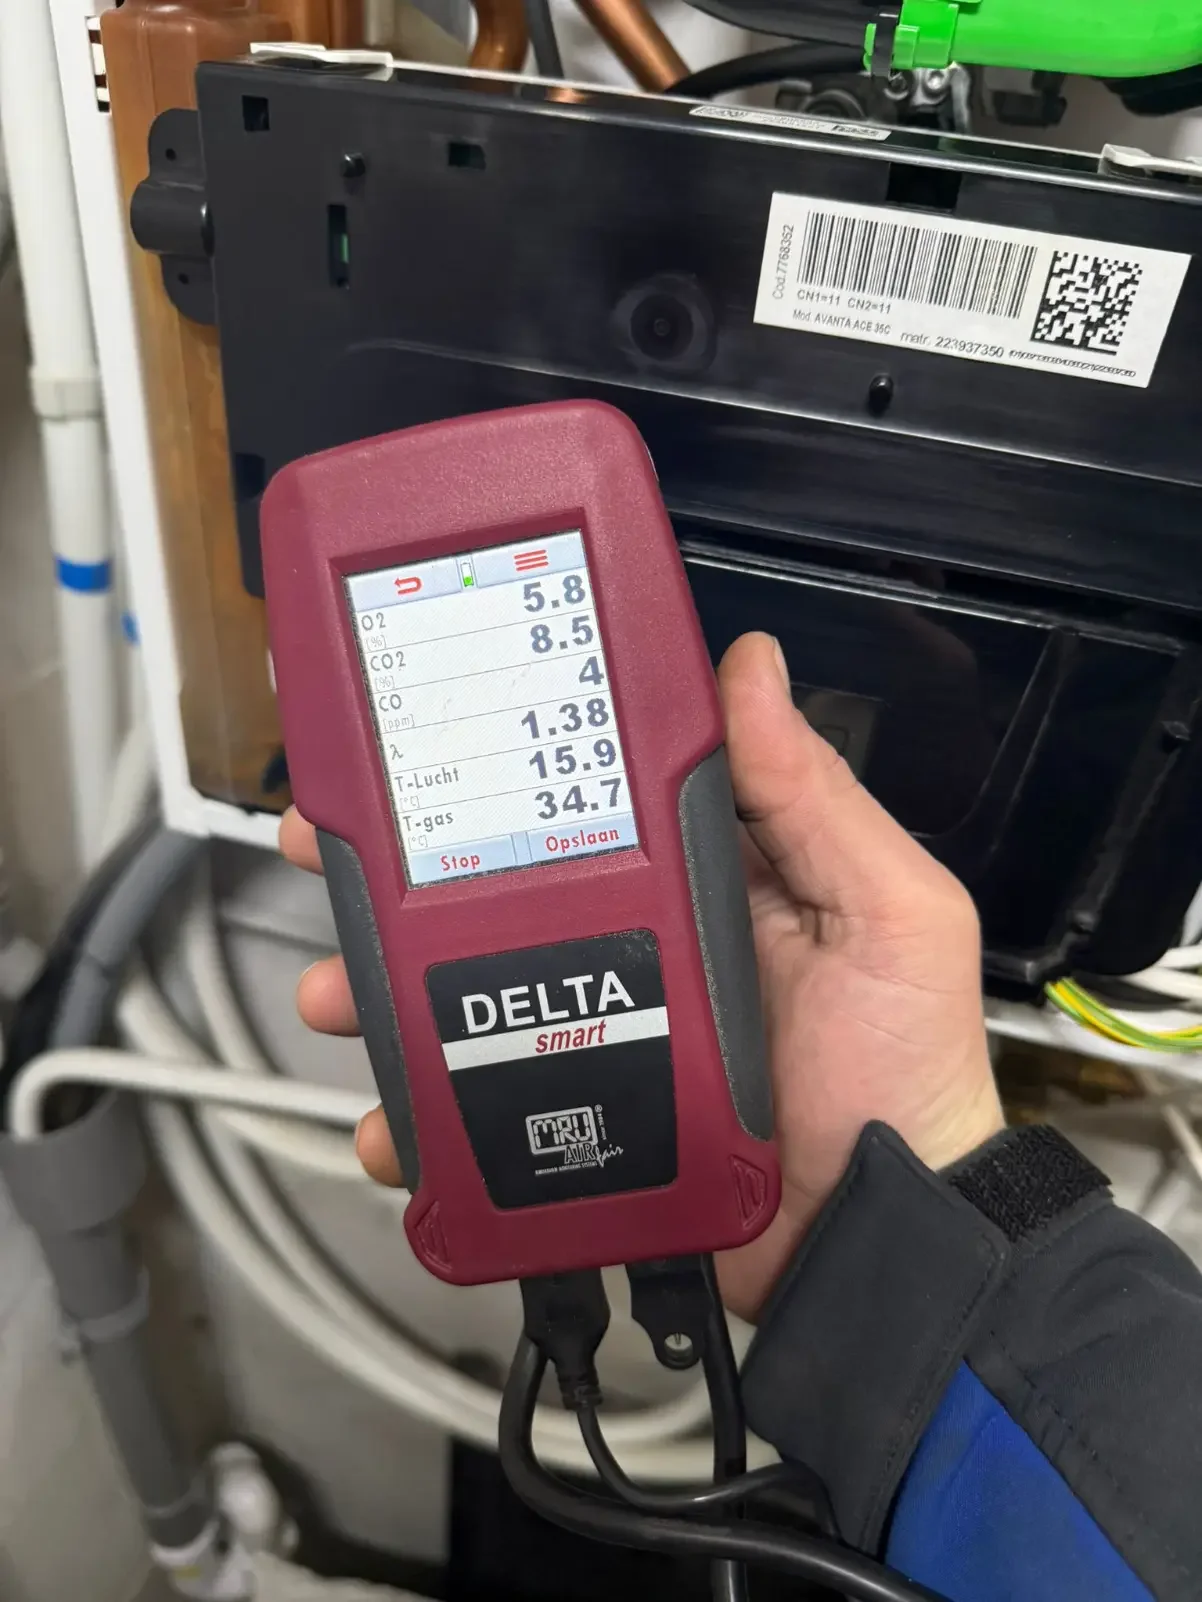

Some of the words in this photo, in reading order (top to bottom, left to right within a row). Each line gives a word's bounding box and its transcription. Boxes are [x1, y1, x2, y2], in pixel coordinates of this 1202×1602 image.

[797, 289, 840, 306] CN1=11
[848, 297, 892, 314] CN2=11
[814, 312, 851, 330] AVANTA
[854, 320, 872, 333] ACE
[936, 335, 1005, 358] 223937350
[523, 574, 586, 613] 5.8
[361, 612, 386, 632] O2
[530, 615, 594, 654] 8.5
[370, 650, 407, 672] CO2
[578, 656, 604, 686] 4
[378, 693, 403, 712] CO
[521, 698, 609, 740] 1.38
[529, 738, 616, 780] 15.9
[394, 766, 460, 793] T-Lucht
[535, 777, 622, 820] 34.7
[402, 811, 454, 834] T-gas
[545, 828, 620, 854] Opslaan
[441, 853, 481, 872] Stop
[461, 970, 636, 1034] DELTA
[535, 1017, 606, 1054] smart
[533, 1113, 592, 1148] MRU
[564, 1142, 596, 1164] AIR
